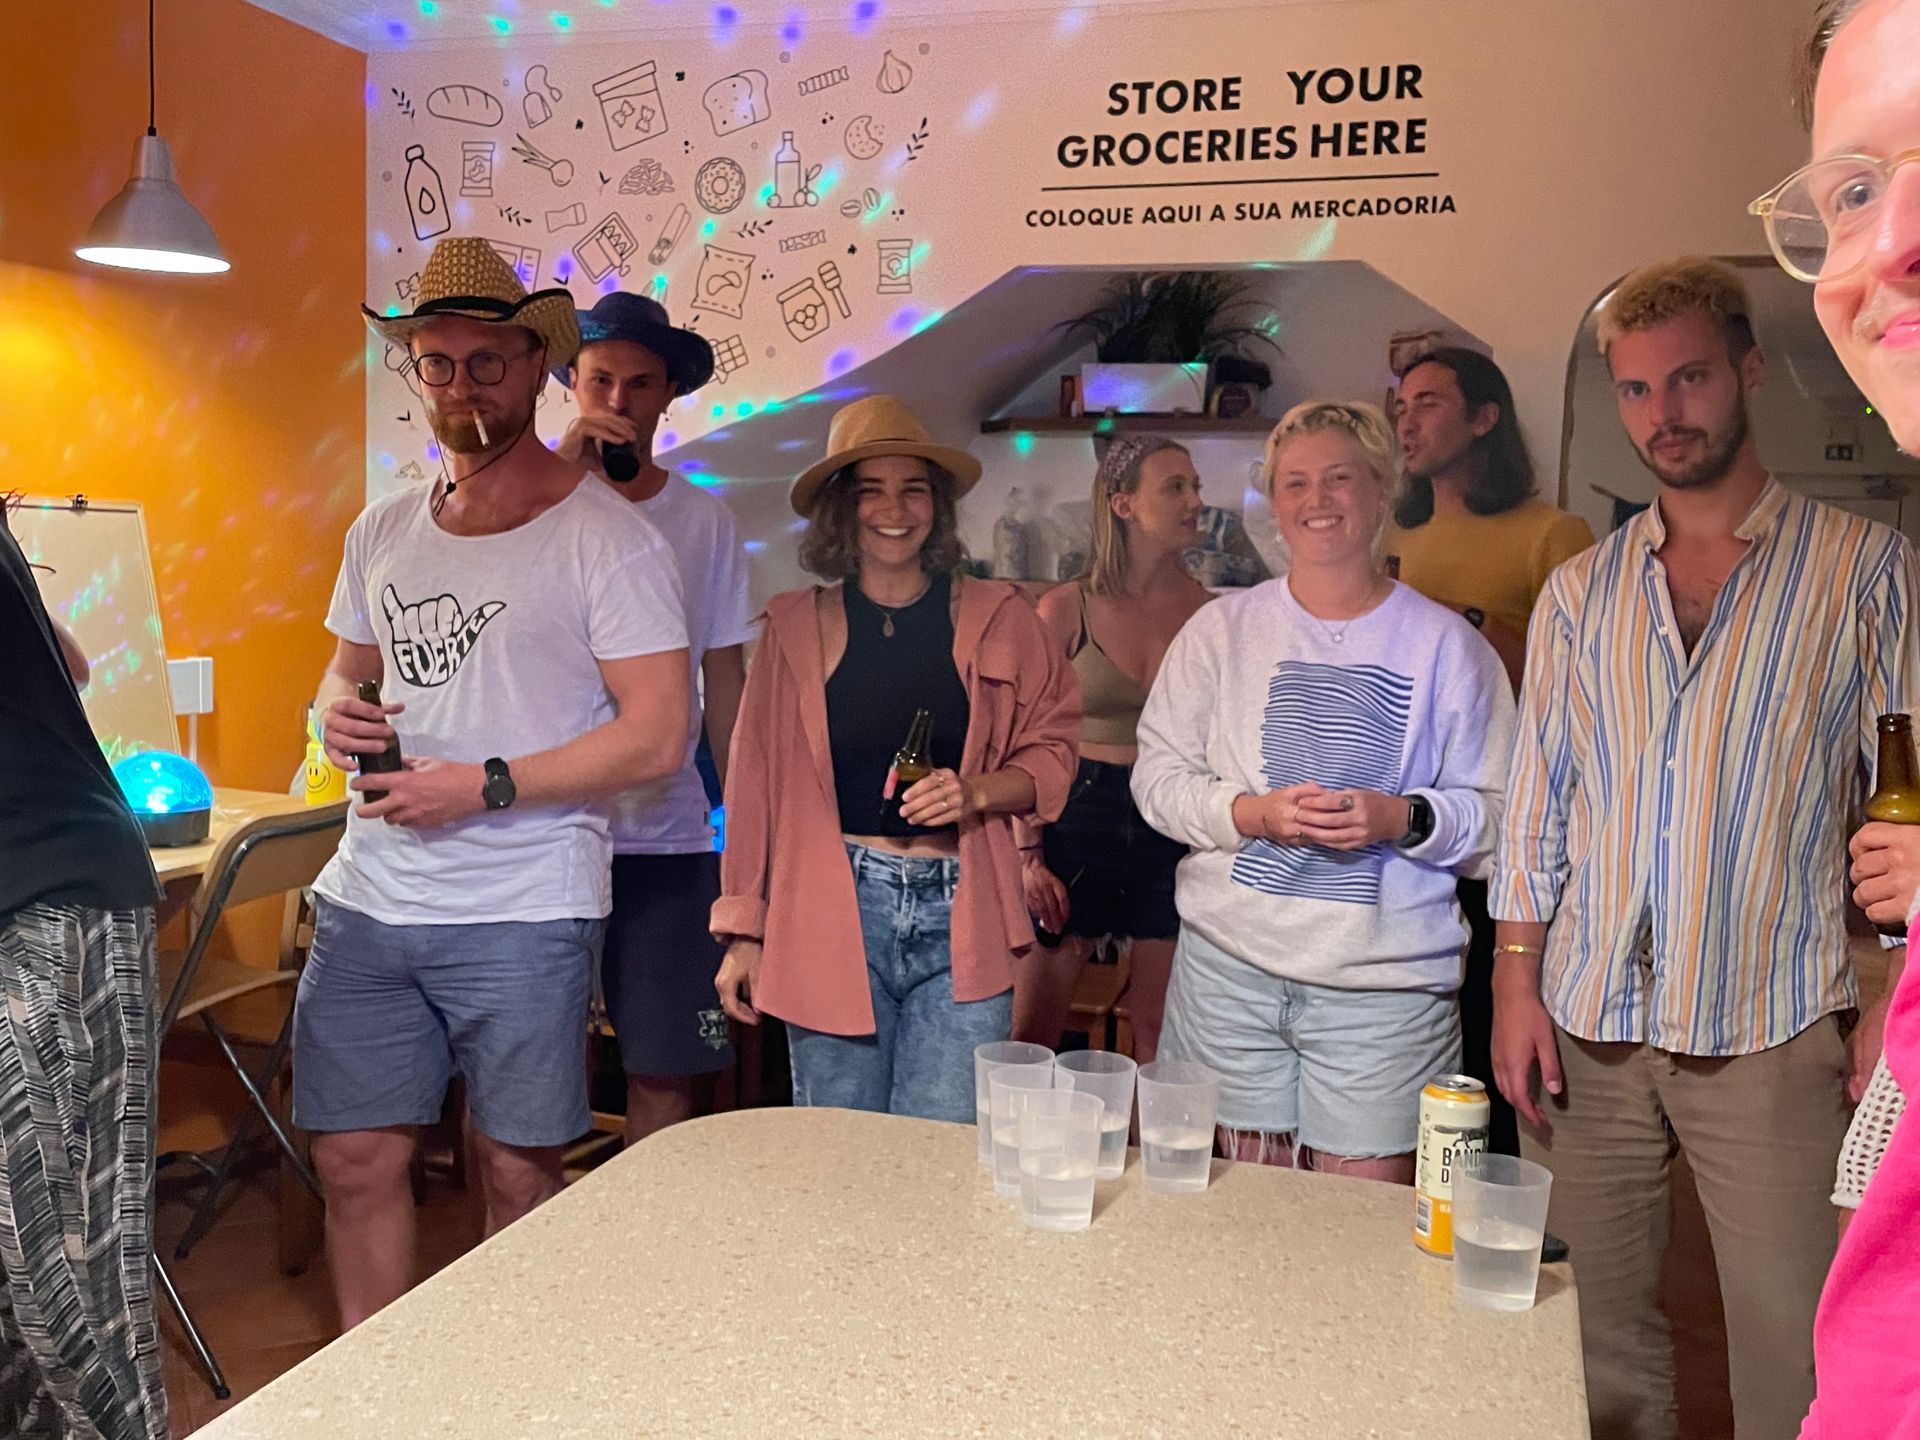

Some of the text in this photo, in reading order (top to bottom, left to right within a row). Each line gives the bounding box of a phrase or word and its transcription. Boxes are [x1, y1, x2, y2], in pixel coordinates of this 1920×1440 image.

[1107, 64, 1423, 116] STORE YOUR
[1057, 118, 1428, 169] GROCERIES HERE
[1025, 194, 1457, 228] COLOQUE AQUI A SUA MERCADORIA
[393, 609, 487, 686] FUERTE
